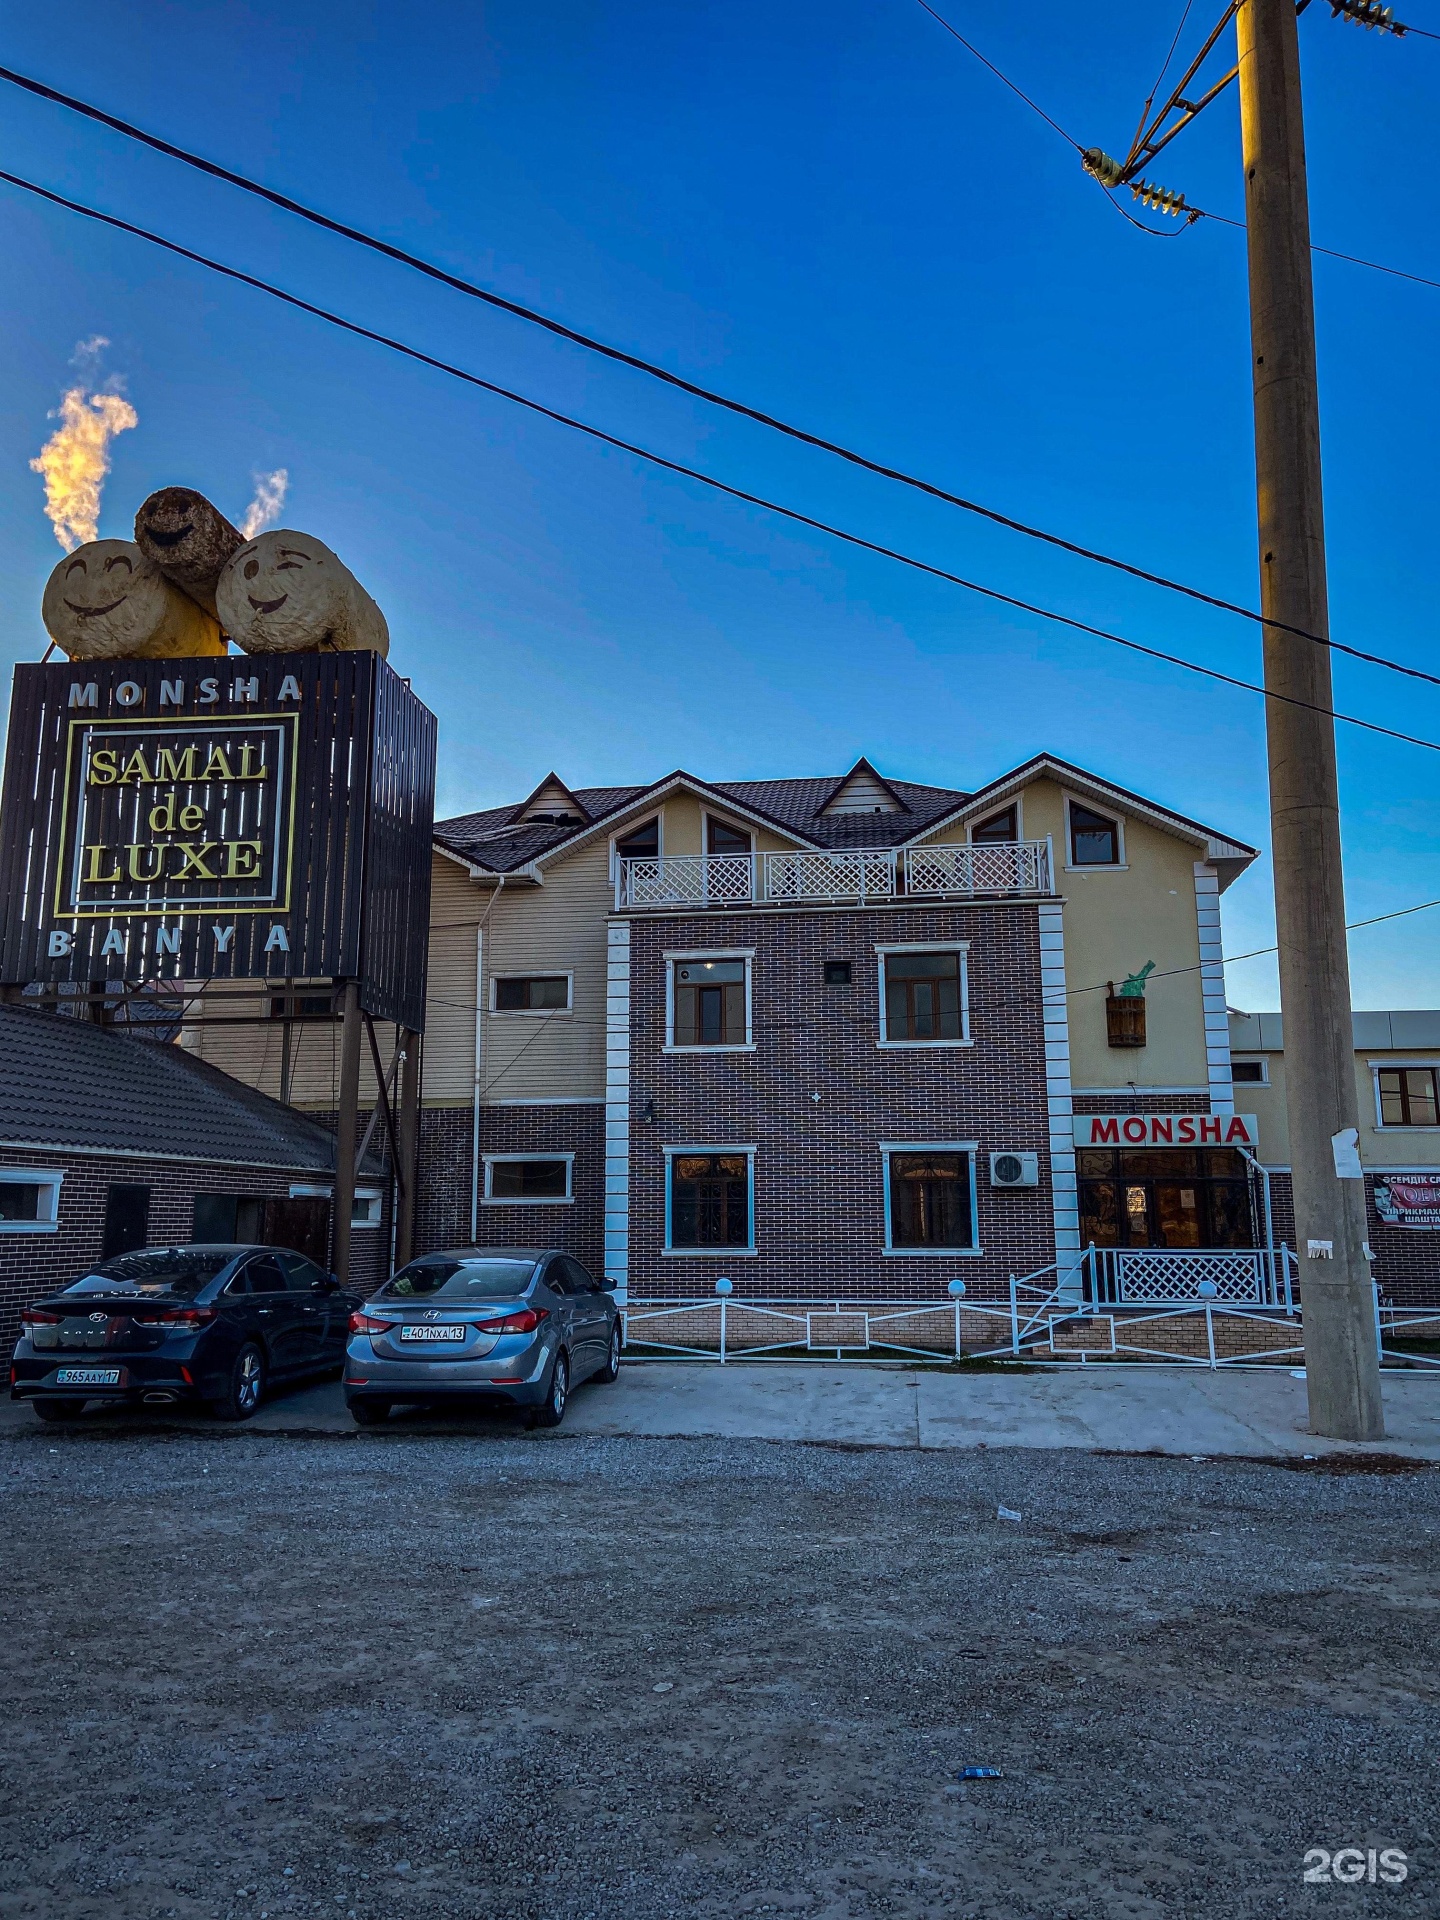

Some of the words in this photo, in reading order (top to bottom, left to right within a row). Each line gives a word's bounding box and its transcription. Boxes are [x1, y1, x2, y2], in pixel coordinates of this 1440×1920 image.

[68, 675, 301, 708] MONSHA
[88, 745, 268, 786] SAMAL
[149, 793, 206, 832] de
[83, 840, 264, 883] LUXE
[48, 924, 291, 957] BANYA
[1090, 1116, 1250, 1143] MONSHA
[1382, 1176, 1428, 1185] ӘСЕМДІК
